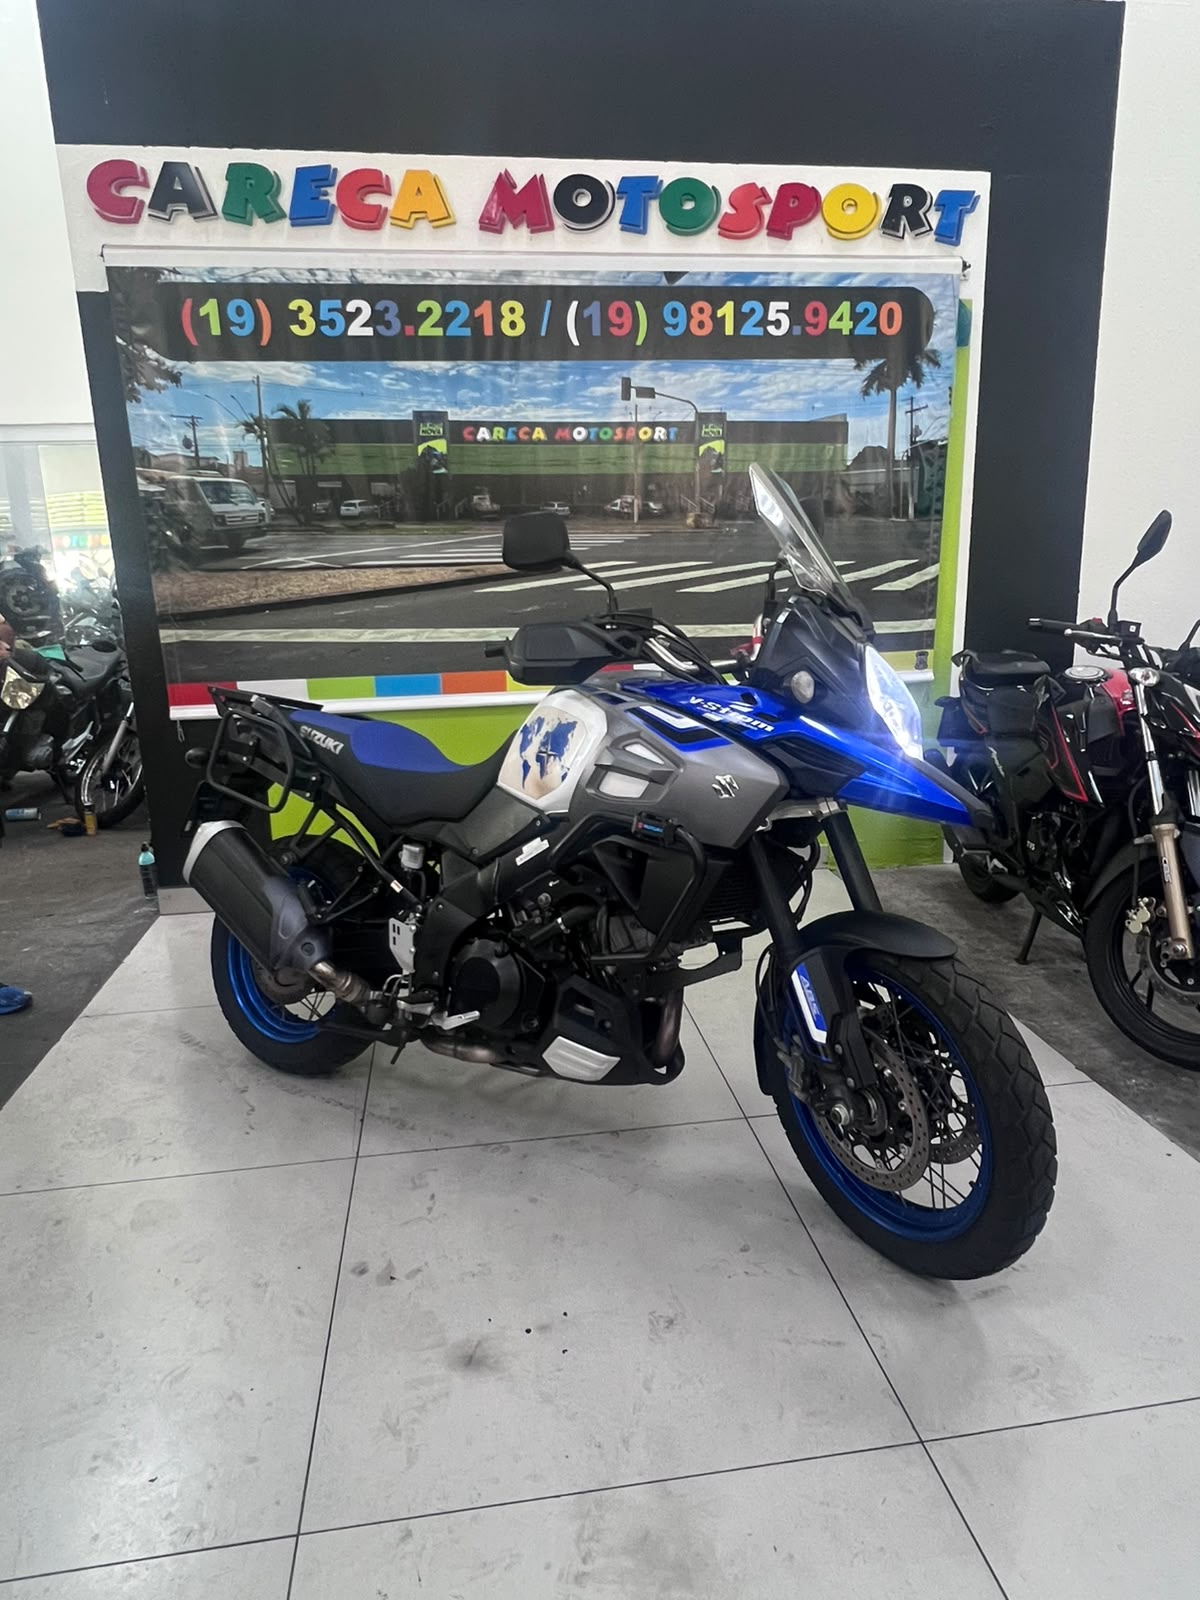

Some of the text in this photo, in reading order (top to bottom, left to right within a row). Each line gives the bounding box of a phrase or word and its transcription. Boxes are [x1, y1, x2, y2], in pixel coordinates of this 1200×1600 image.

[86, 158, 981, 246] CARECA MOTOSPORT
[181, 298, 272, 346] (19)
[288, 299, 527, 337] 3523.2218
[566, 300, 648, 346] (19)
[663, 300, 903, 337] 98125.9420
[462, 426, 679, 442] CARECA MOTOSPORT
[300, 725, 345, 755] SUZUKI
